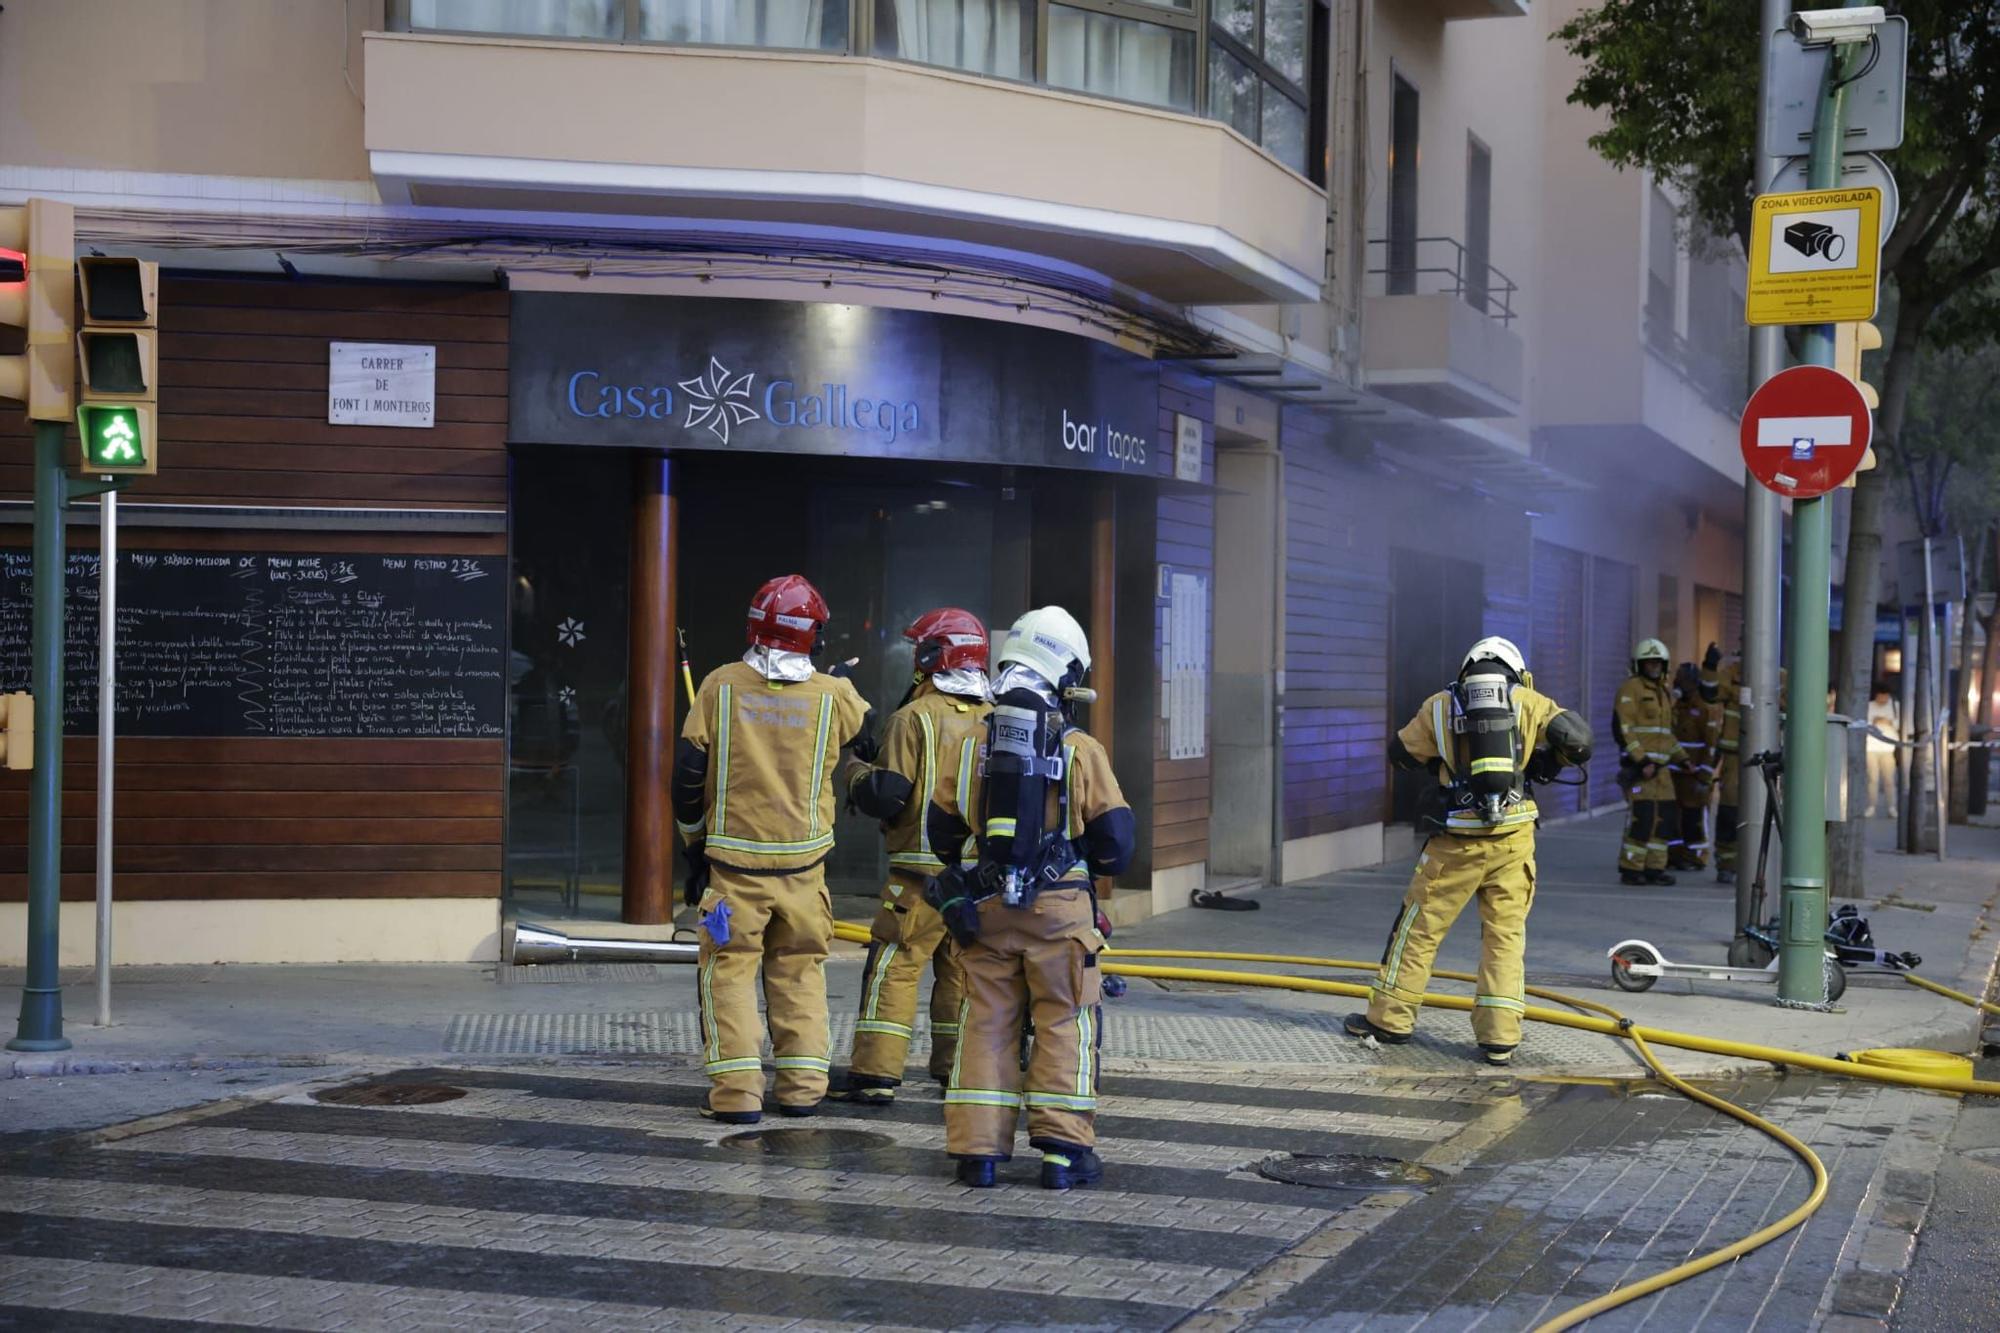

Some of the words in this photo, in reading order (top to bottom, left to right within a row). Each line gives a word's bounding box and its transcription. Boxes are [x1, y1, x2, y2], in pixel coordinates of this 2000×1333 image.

[1761, 201, 1790, 210] ZONA
[1793, 192, 1873, 207] VIDEOVIGILADA
[361, 357, 404, 371] CARRER
[375, 378, 389, 391] DE
[333, 398, 361, 411] FONT
[365, 399, 369, 411] I
[373, 400, 431, 413] MONTEROS
[568, 371, 673, 419] Casa
[765, 381, 920, 444] Gallega
[1063, 409, 1097, 452] bar
[1107, 424, 1146, 470] tapas
[268, 557, 293, 568] MENU
[383, 558, 407, 569] MENU
[1035, 633, 1057, 650] PALMA
[1472, 689, 1494, 699] MSA
[1001, 726, 1029, 742] MSA
